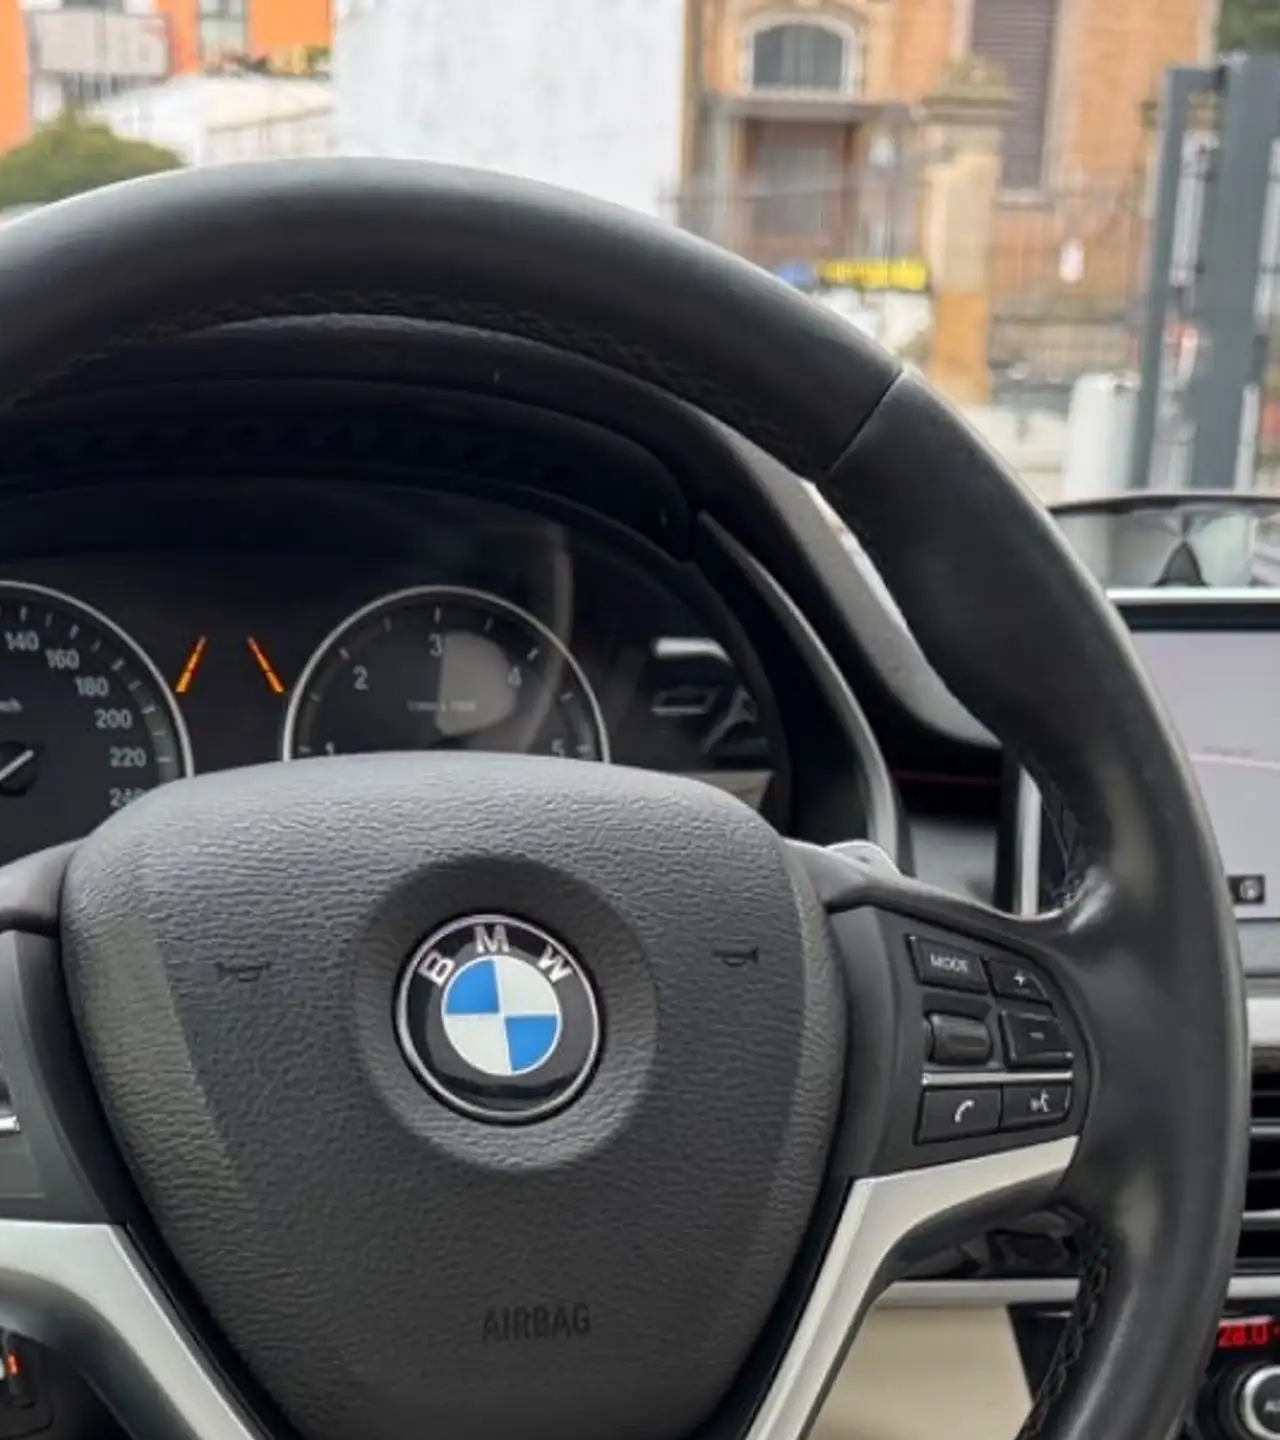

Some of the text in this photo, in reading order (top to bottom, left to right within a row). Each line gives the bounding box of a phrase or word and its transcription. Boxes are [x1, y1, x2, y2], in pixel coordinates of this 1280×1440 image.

[5, 630, 40, 651] 140
[428, 633, 444, 658] 3
[45, 650, 80, 670] 160
[75, 676, 109, 697] 180
[353, 664, 369, 690] 2
[94, 708, 133, 730] 200
[109, 746, 147, 768] 220
[418, 924, 575, 988] BMW
[481, 1301, 592, 1342] AIRBAG
